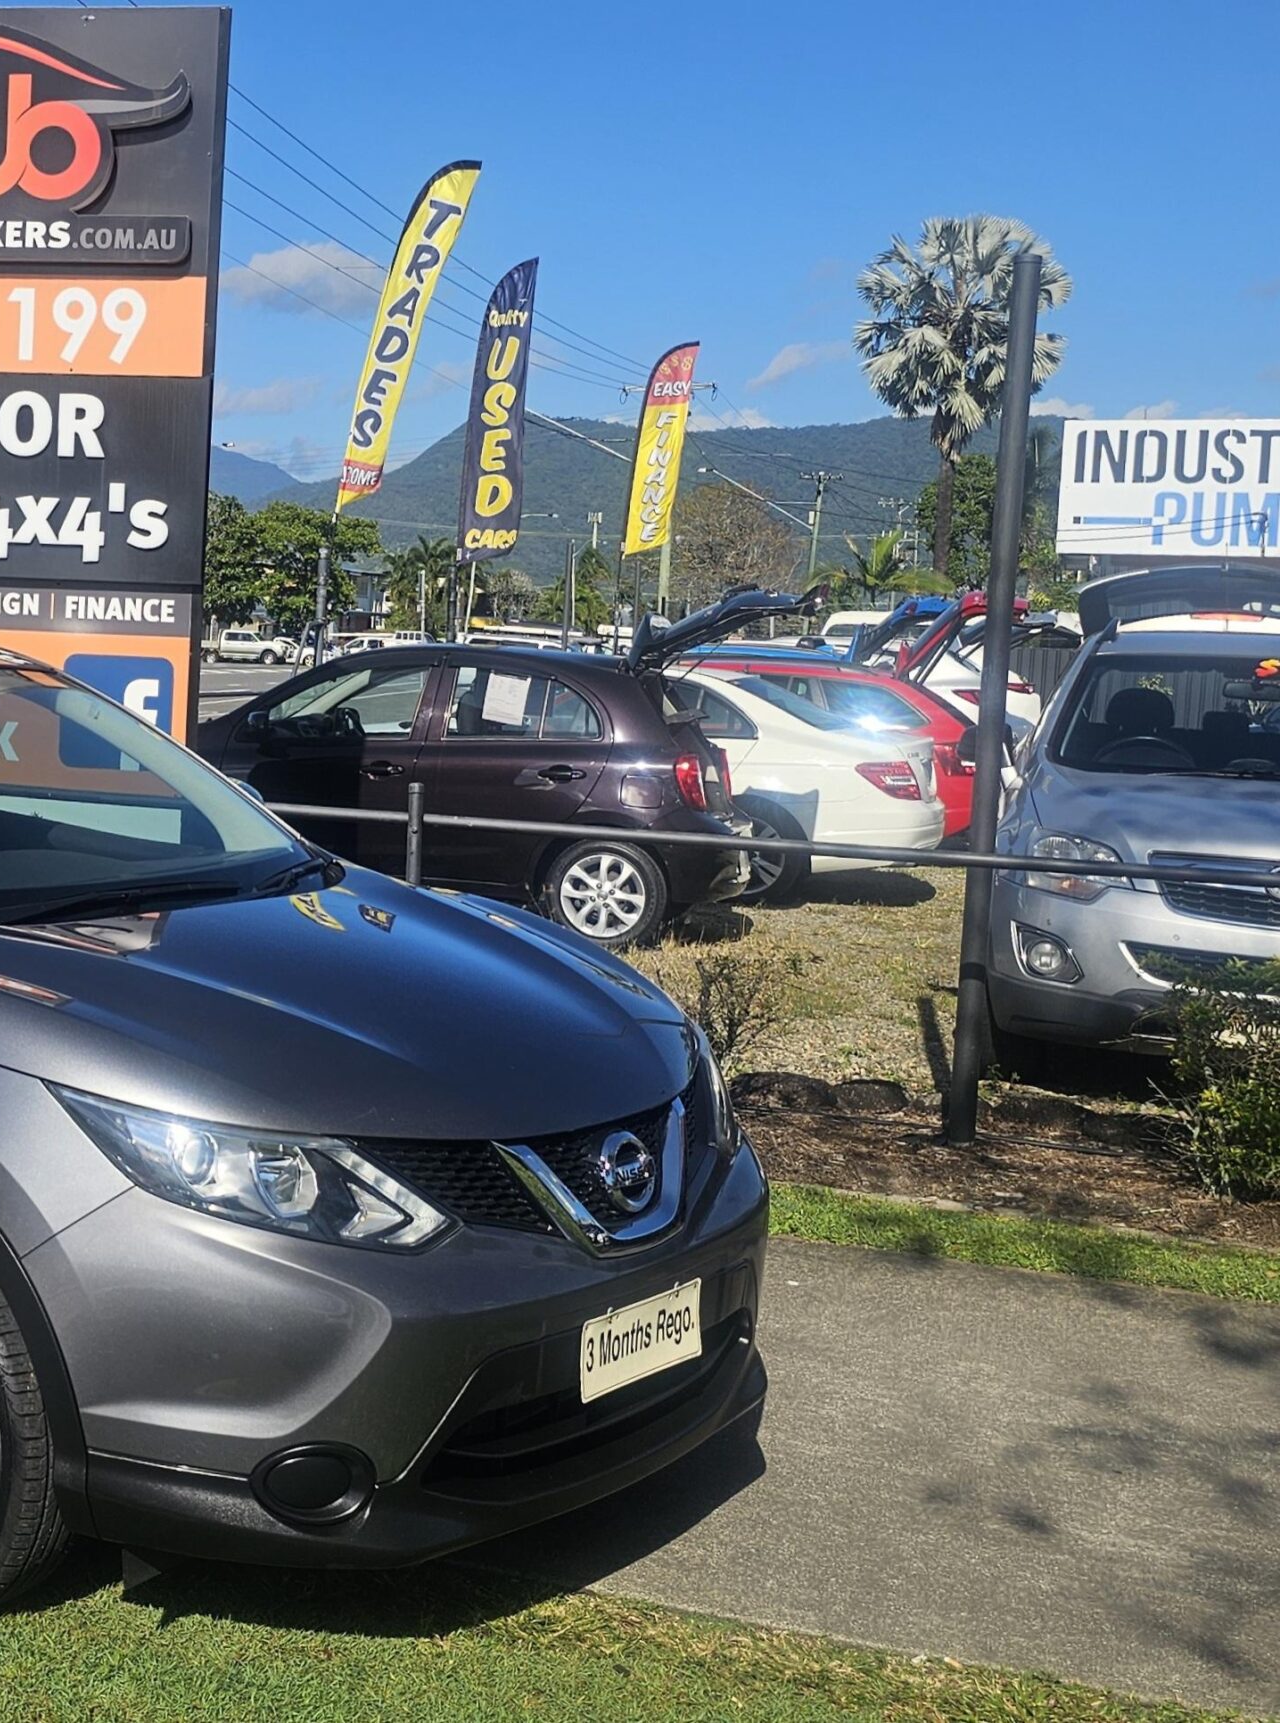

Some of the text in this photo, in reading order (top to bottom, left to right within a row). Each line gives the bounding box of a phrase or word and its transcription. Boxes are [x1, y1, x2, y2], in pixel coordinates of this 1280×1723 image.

[8, 287, 147, 364] 199
[353, 199, 462, 449] TRADES
[653, 380, 693, 397] EASY
[475, 336, 520, 517] USED
[1073, 429, 1280, 484] INDUST
[639, 411, 678, 542] FINANCE
[464, 529, 517, 550] CARS
[64, 595, 176, 623] FINANCE
[586, 1307, 694, 1372] 3 Months Rego.
